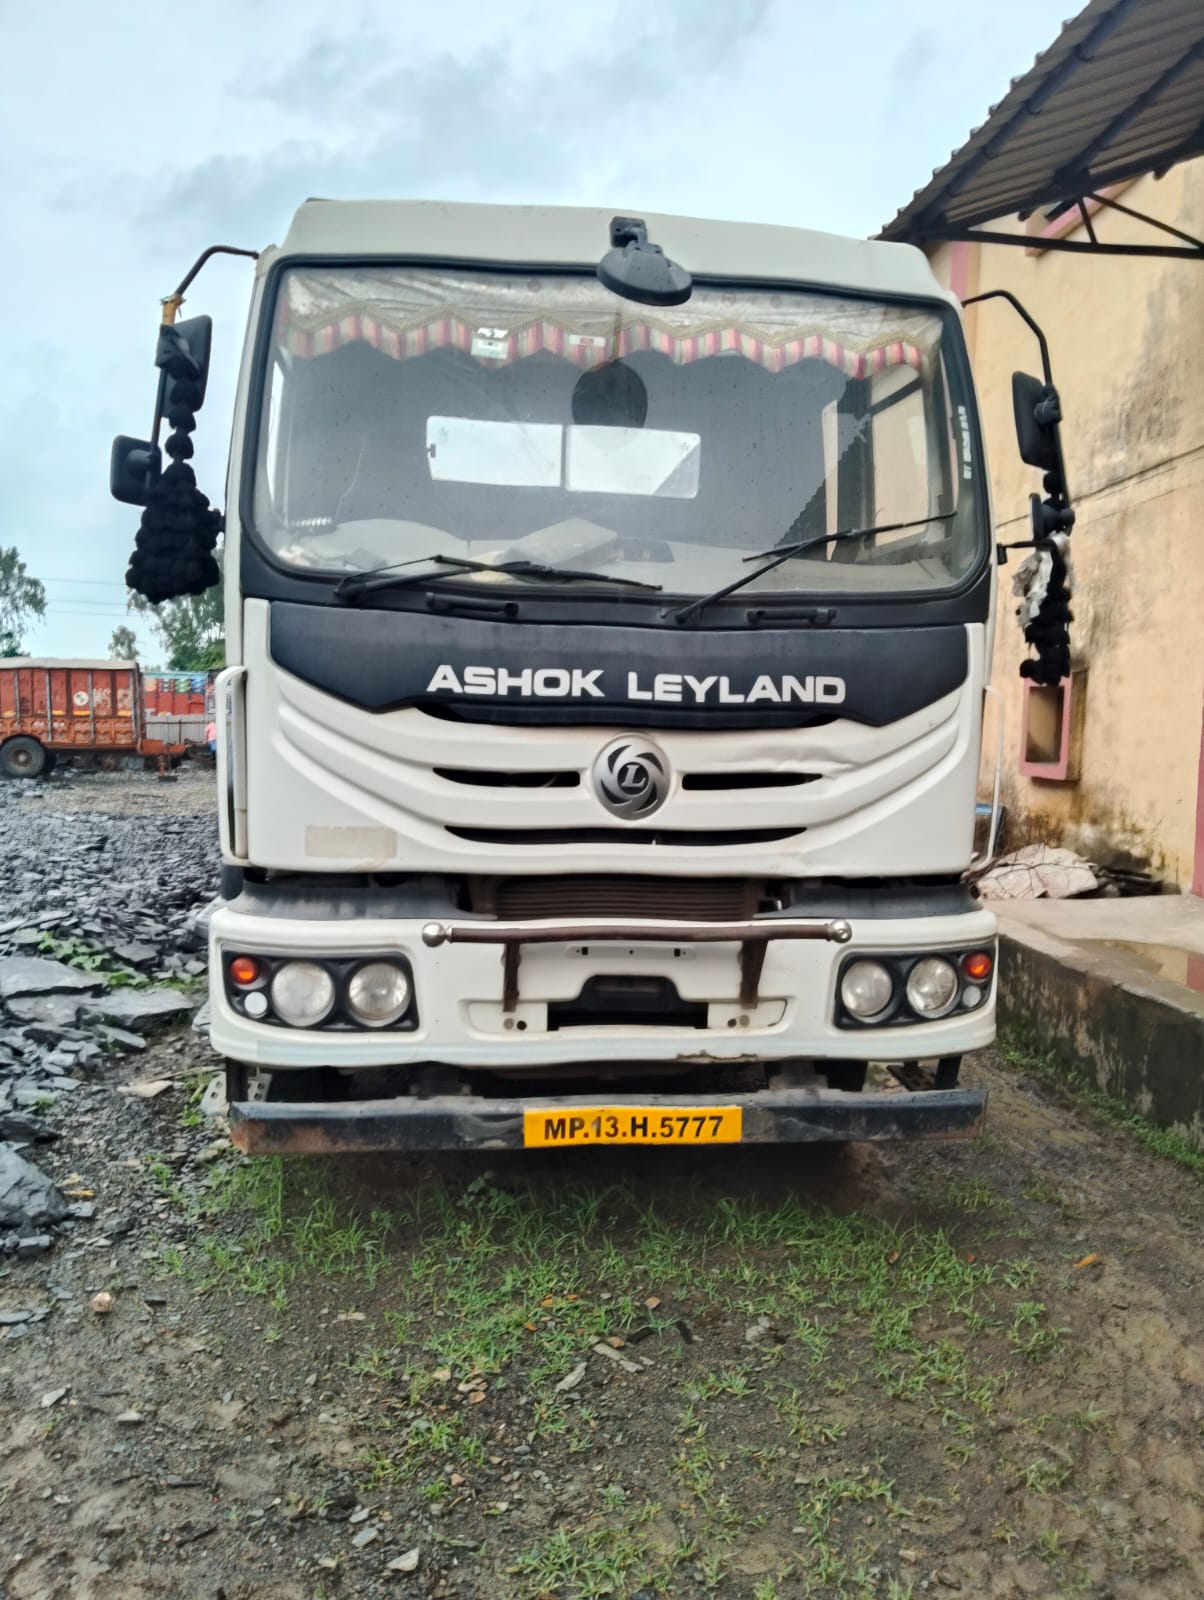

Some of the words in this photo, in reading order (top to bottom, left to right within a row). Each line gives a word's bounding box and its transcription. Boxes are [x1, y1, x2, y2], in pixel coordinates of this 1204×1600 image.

[426, 665, 604, 697] ASHOK
[628, 672, 846, 704] LEYLAND
[544, 1115, 723, 1140] MP.13.H.5777
